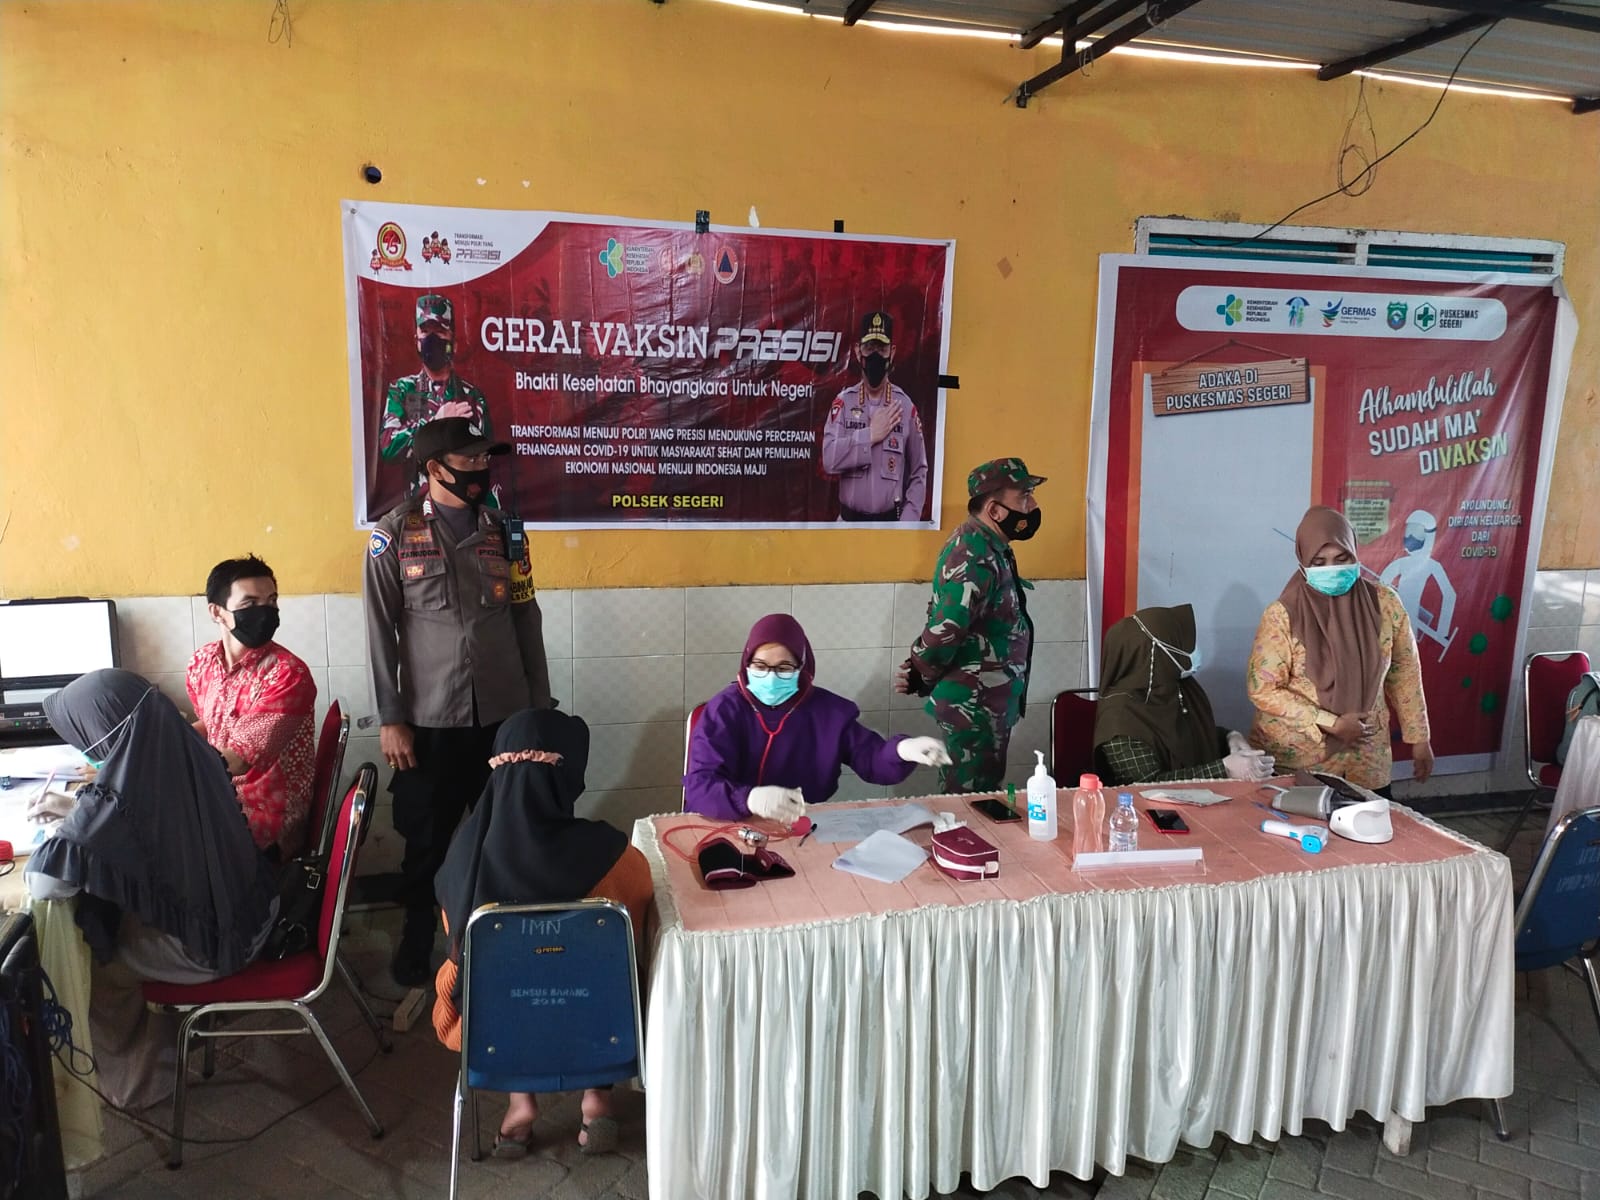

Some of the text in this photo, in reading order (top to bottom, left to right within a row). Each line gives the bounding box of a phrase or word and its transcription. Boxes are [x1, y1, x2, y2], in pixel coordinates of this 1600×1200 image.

[1341, 306, 1377, 317] GERMAS
[1439, 309, 1479, 319] PUSKESMAS
[1439, 319, 1462, 329] SEGERI
[480, 316, 842, 362] GERAI VAKSIN PRESISI
[1199, 368, 1259, 388] ADAKA DI
[516, 372, 813, 401] Bhakti Kesehatan Bhayangkara Untuk Negeri
[1166, 384, 1292, 411] PUSKESMAS SEGERI
[1358, 368, 1496, 424] Alhamdulillah
[511, 425, 815, 442] TRANSFORMASI MENUJU POLRI YANG PRESISI MENDUKUNG PERCEPATAN
[1369, 409, 1482, 456] SUDAH MA'
[516, 443, 811, 459] PENANGANAN COVID-19 UNTUK MASYARAKAT SEHAT DAN PEMULIHAN
[1419, 432, 1508, 475] DIVAKSIN
[565, 461, 767, 476] EKONOMI NASIONAL MENUJU INDONESIA MAJU
[612, 495, 724, 508] POLSEK SEGERI
[1461, 499, 1513, 510] AYO LINDUNGI
[1448, 516, 1463, 527] DIRI
[1480, 514, 1522, 526] KELUARGA
[1472, 531, 1490, 542] DARI
[1461, 546, 1497, 557] COVID-19
